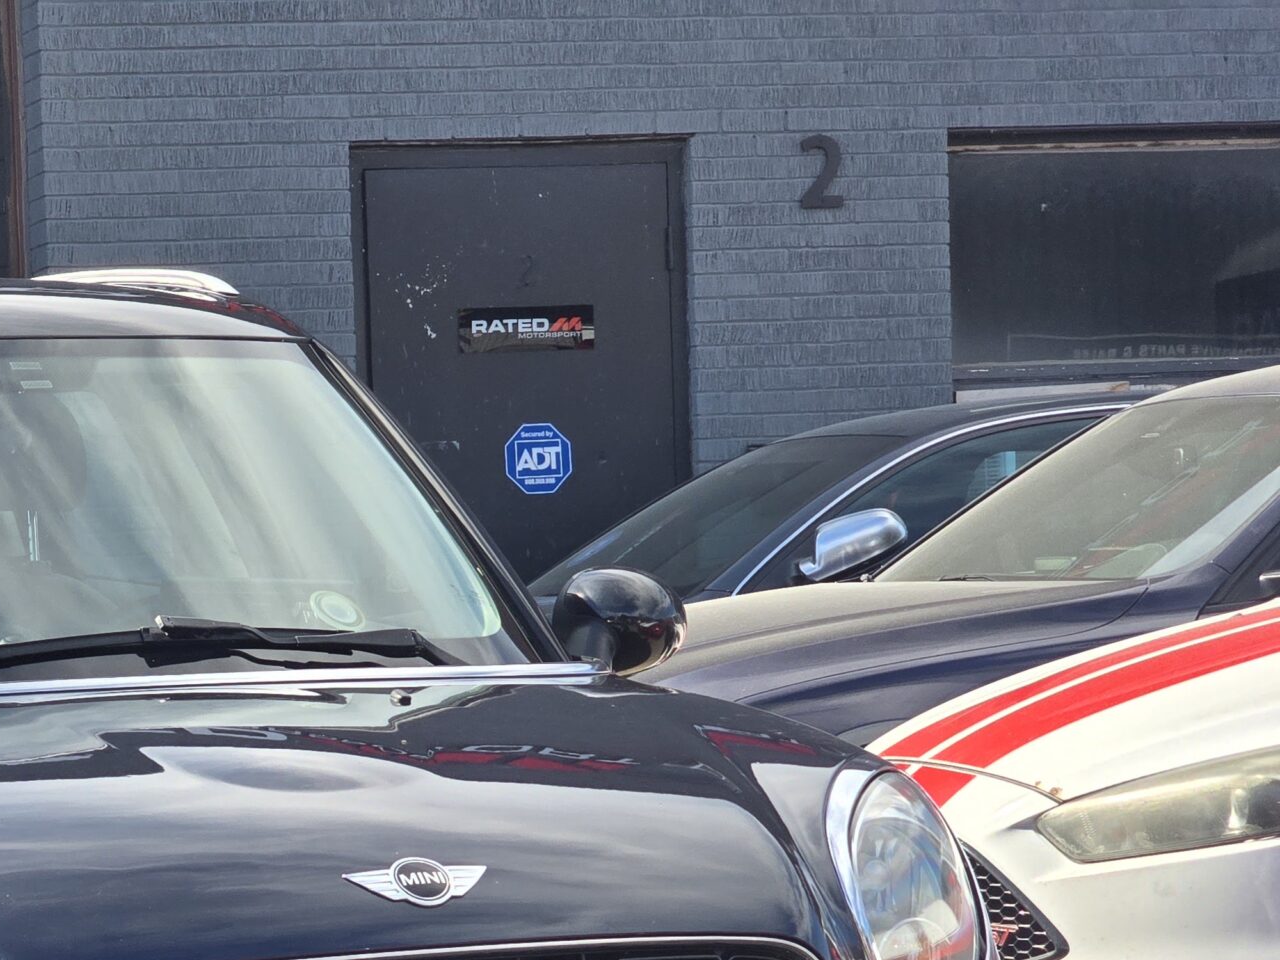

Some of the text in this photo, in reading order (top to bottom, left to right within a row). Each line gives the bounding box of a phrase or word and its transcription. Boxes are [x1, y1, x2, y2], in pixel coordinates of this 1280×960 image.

[800, 134, 844, 209] 2
[471, 317, 550, 334] RATED
[518, 331, 582, 340] MOTORSPORT
[545, 430, 554, 438] by
[517, 446, 561, 471] ADT
[399, 871, 446, 887] MINI
